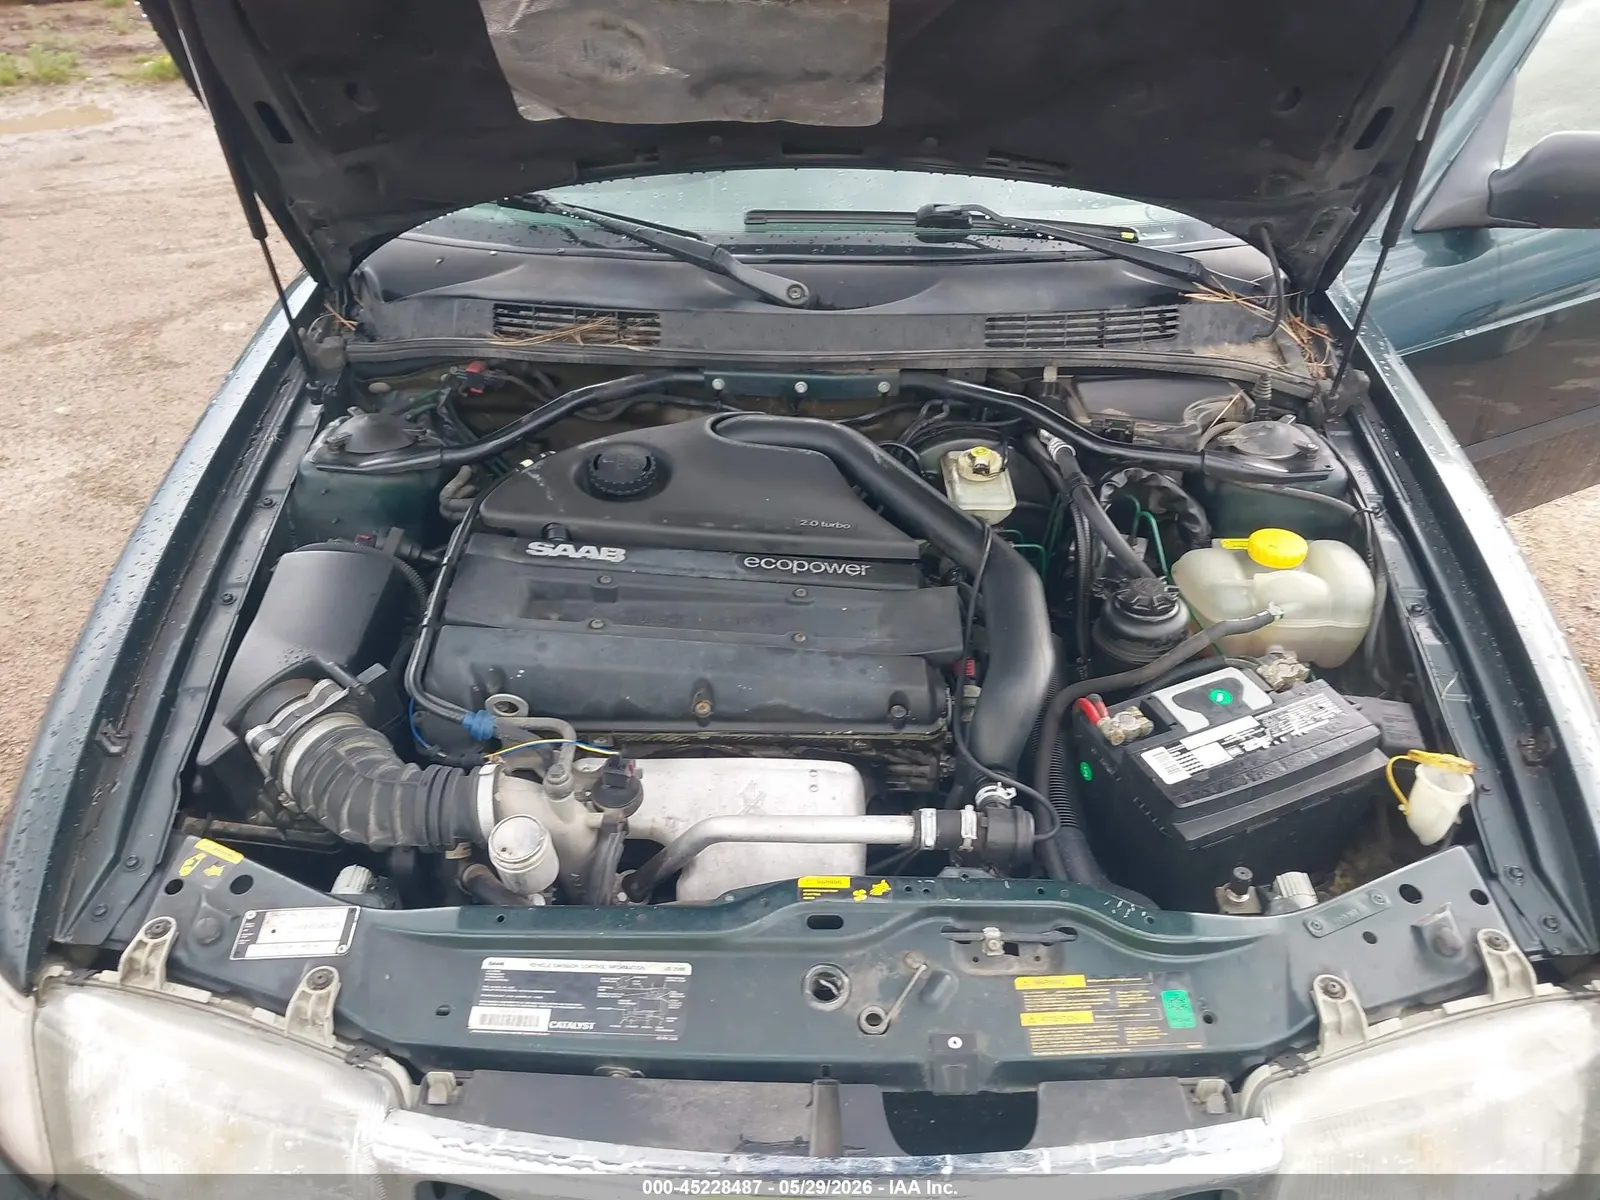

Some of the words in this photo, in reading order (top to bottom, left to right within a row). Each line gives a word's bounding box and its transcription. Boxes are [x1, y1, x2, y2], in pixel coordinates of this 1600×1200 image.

[799, 519, 819, 527] 2.0
[821, 520, 852, 530] turbo
[525, 541, 627, 563] SAAB
[743, 556, 872, 577] ecopower
[549, 1020, 596, 1030] CATALYST
